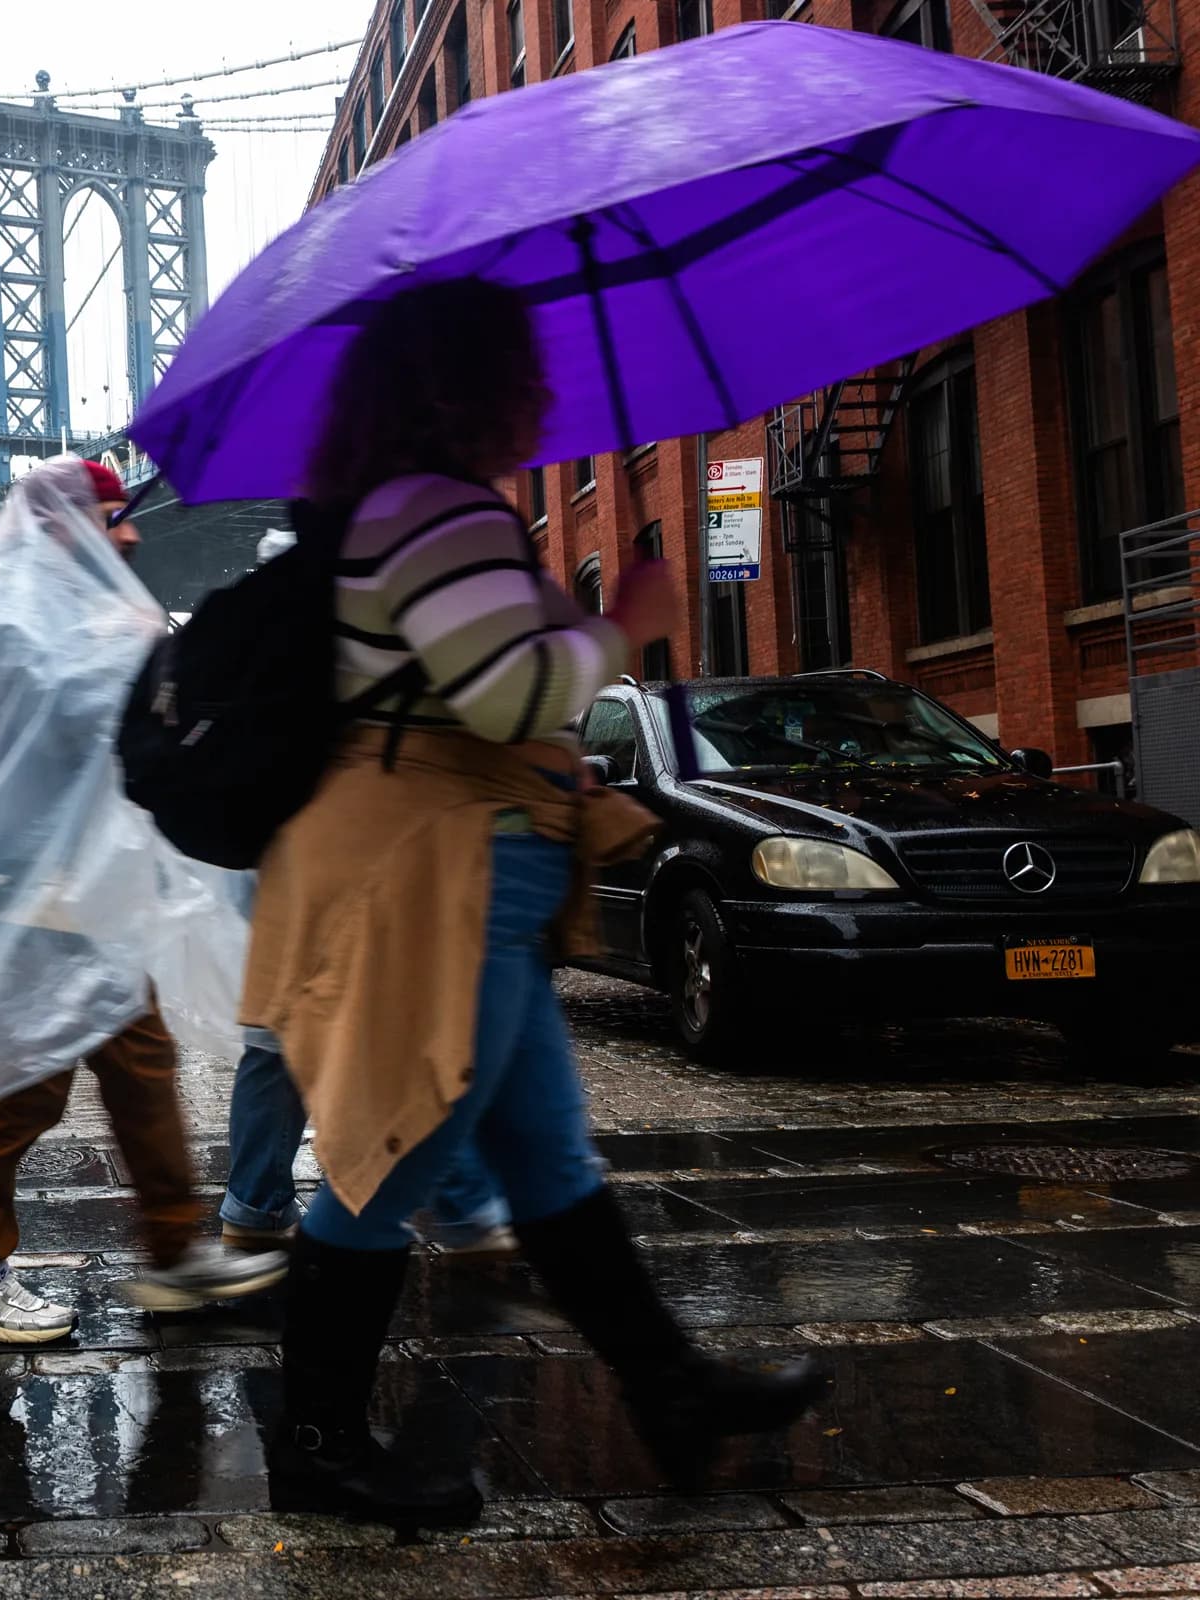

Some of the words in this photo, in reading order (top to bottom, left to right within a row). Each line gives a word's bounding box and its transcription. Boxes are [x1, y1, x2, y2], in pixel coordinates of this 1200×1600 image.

[709, 513, 718, 528] 2
[1050, 937, 1071, 945] YORK
[1014, 950, 1040, 973] HVN
[1050, 949, 1084, 971] 2281
